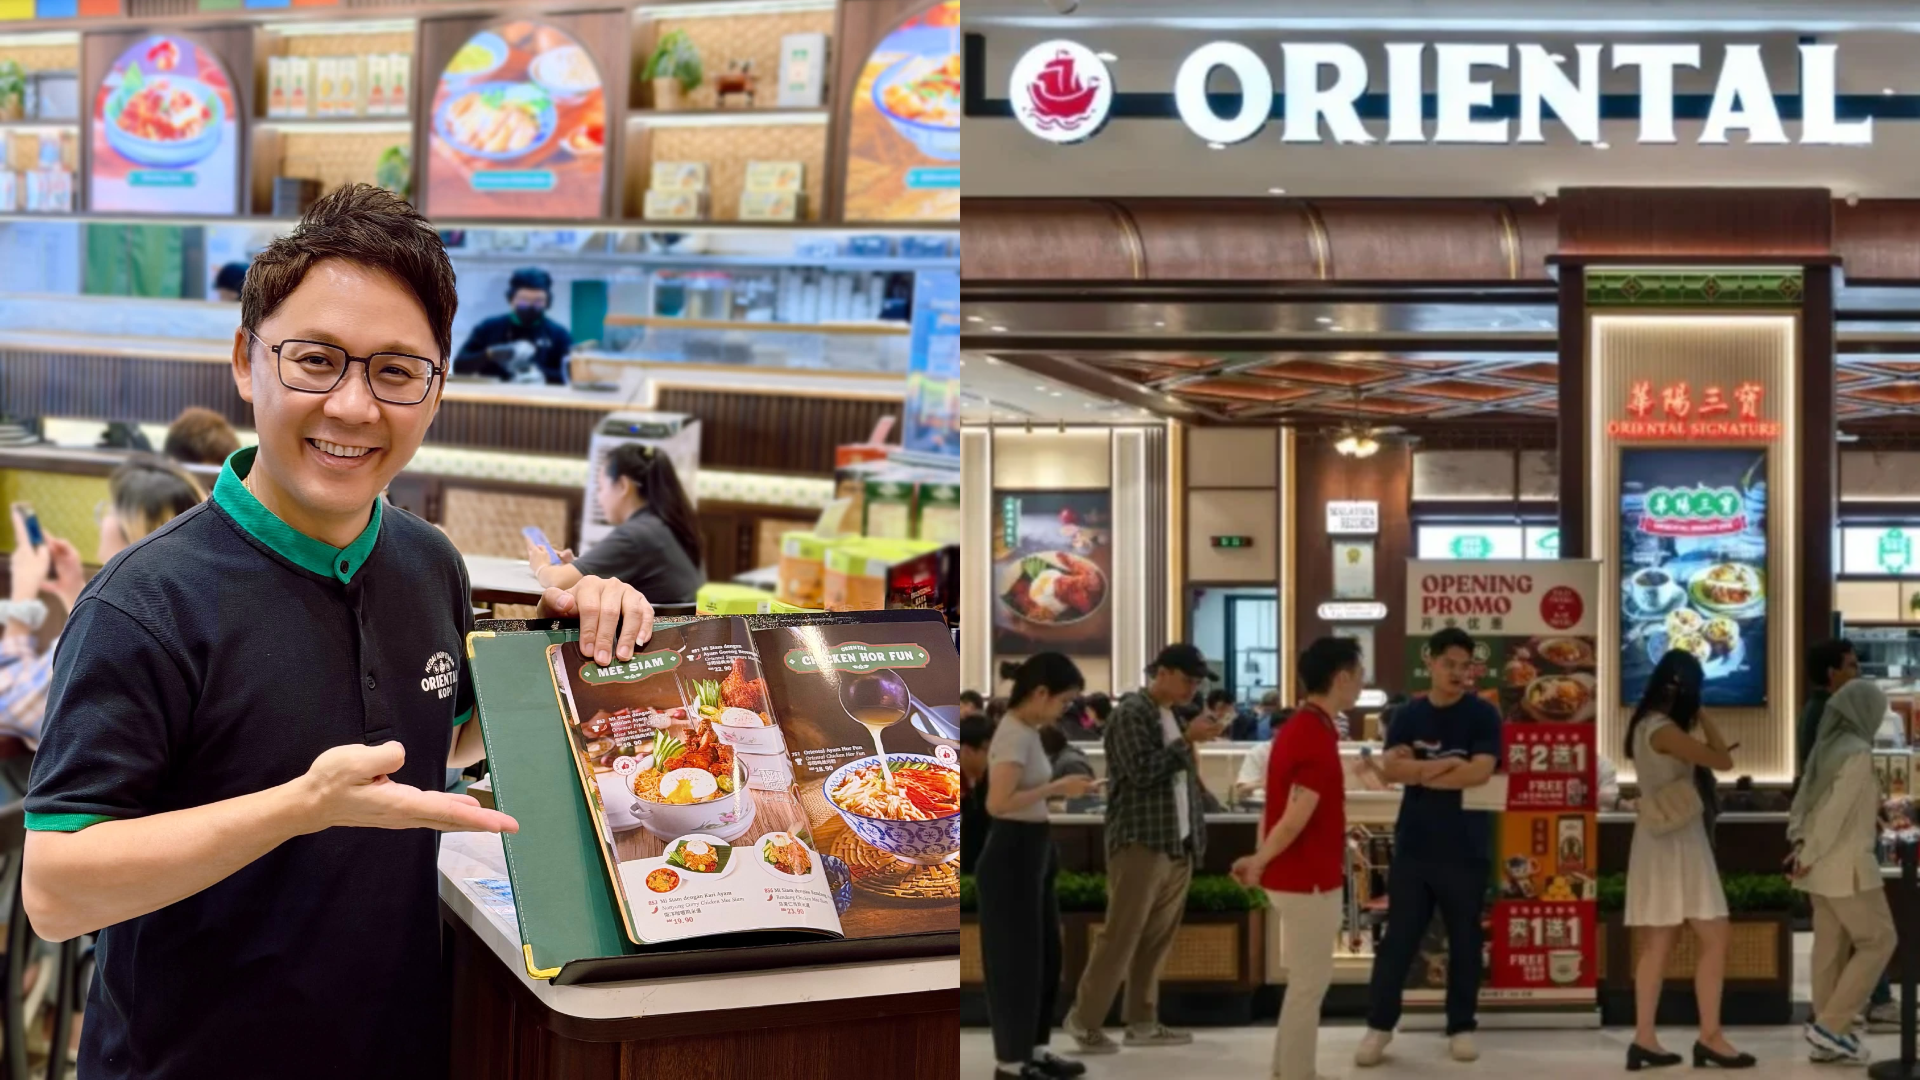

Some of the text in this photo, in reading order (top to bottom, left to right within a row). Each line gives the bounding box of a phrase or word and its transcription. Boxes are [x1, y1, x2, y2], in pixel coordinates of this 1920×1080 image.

[1174, 41, 1873, 146] ORIENTAL
[1608, 422, 1782, 436] ORIENTAL SIGNATURE
[1421, 574, 1533, 594] OPENING
[1421, 596, 1512, 615] PROMO
[859, 651, 886, 661] HOR
[888, 650, 914, 661] FUN
[596, 657, 664, 678] MEE SIAM
[438, 686, 452, 699] KOPI
[1529, 780, 1563, 791] FREE
[673, 916, 694, 925] 19.90
[1509, 953, 1545, 966] FREE
